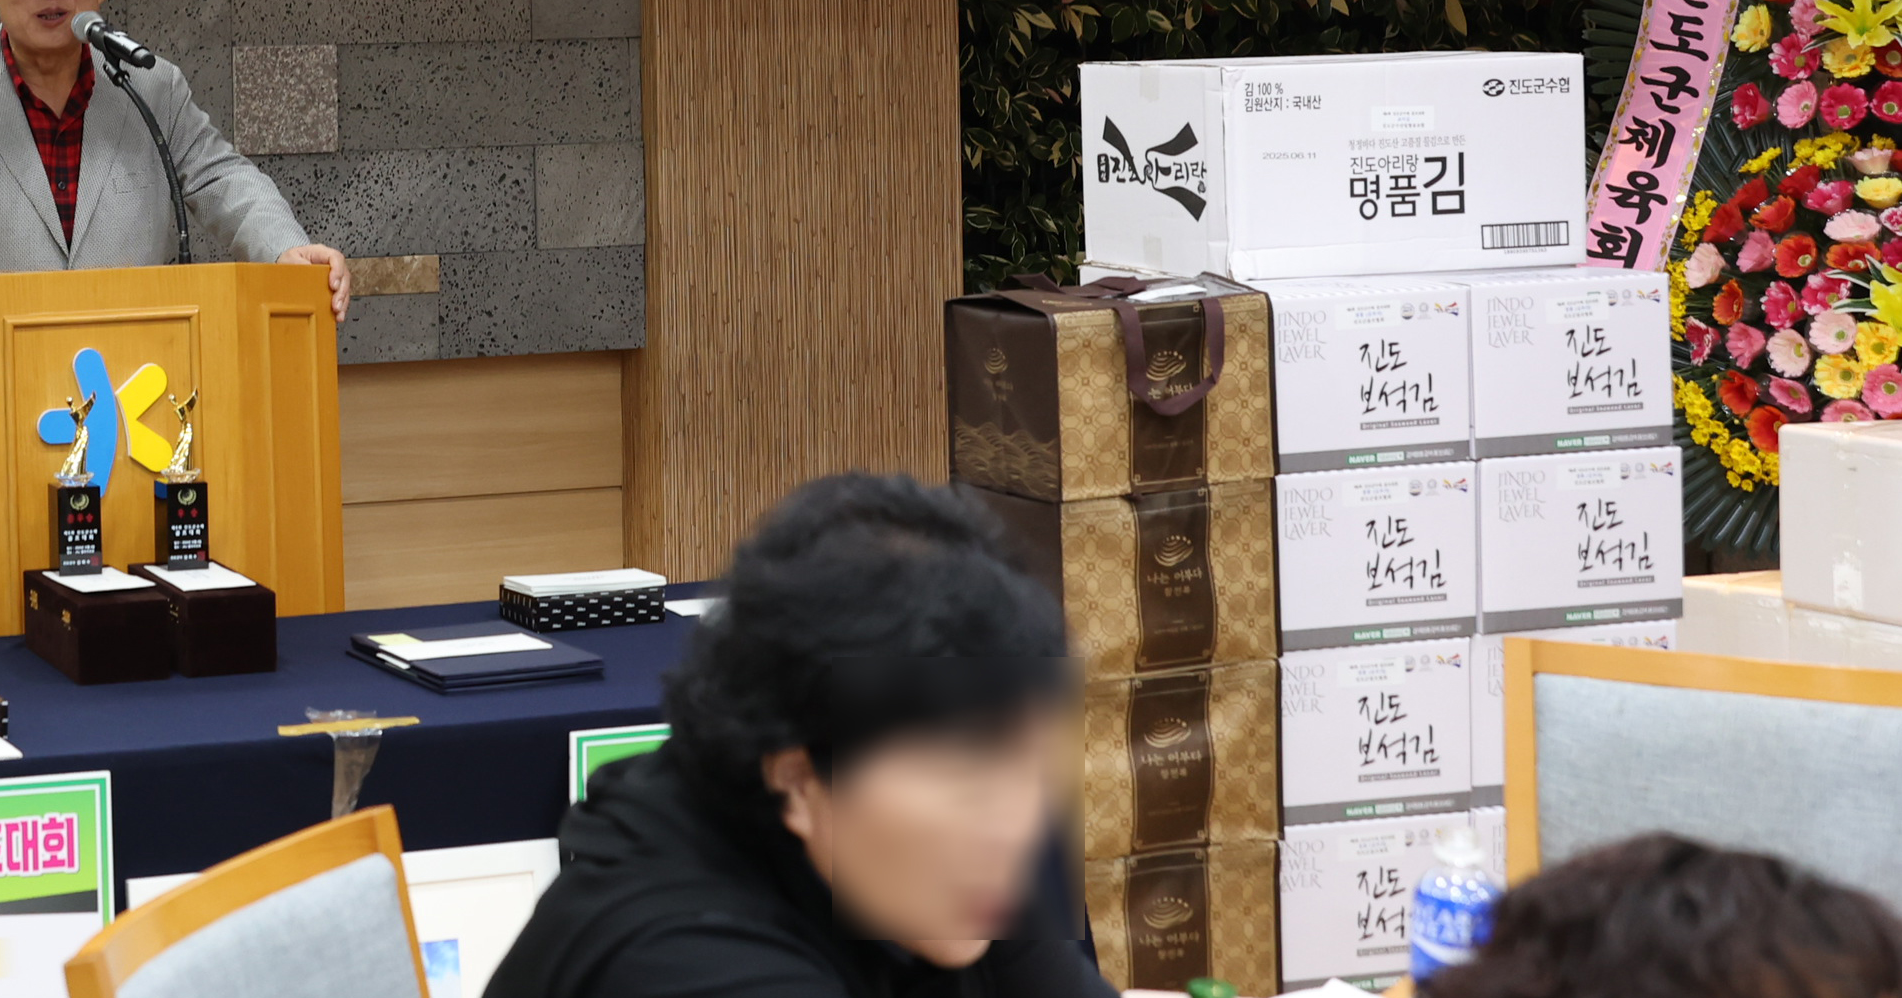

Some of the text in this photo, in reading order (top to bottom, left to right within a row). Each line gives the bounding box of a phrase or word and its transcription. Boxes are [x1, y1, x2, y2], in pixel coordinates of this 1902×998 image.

[1244, 82, 1254, 97] 김
[1258, 83, 1272, 96] 100
[1509, 77, 1570, 95] 진도군수협
[1244, 97, 1283, 113] 김원산지
[1293, 95, 1321, 111] 국내산
[1350, 154, 1419, 175] 진도아리랑
[1359, 339, 1408, 373] 진도
[1565, 324, 1612, 358] 진도
[1360, 373, 1440, 415] 보석김
[1567, 358, 1643, 399] 보석김
[1365, 515, 1415, 549] 진도
[1576, 498, 1624, 532] 진도
[1578, 532, 1654, 572] 보석김
[1366, 549, 1447, 591] 보석김
[1358, 691, 1408, 725] 진도
[1358, 725, 1440, 767] 보석김
[1357, 866, 1407, 899] 진도
[1357, 902, 1413, 941] 보석
